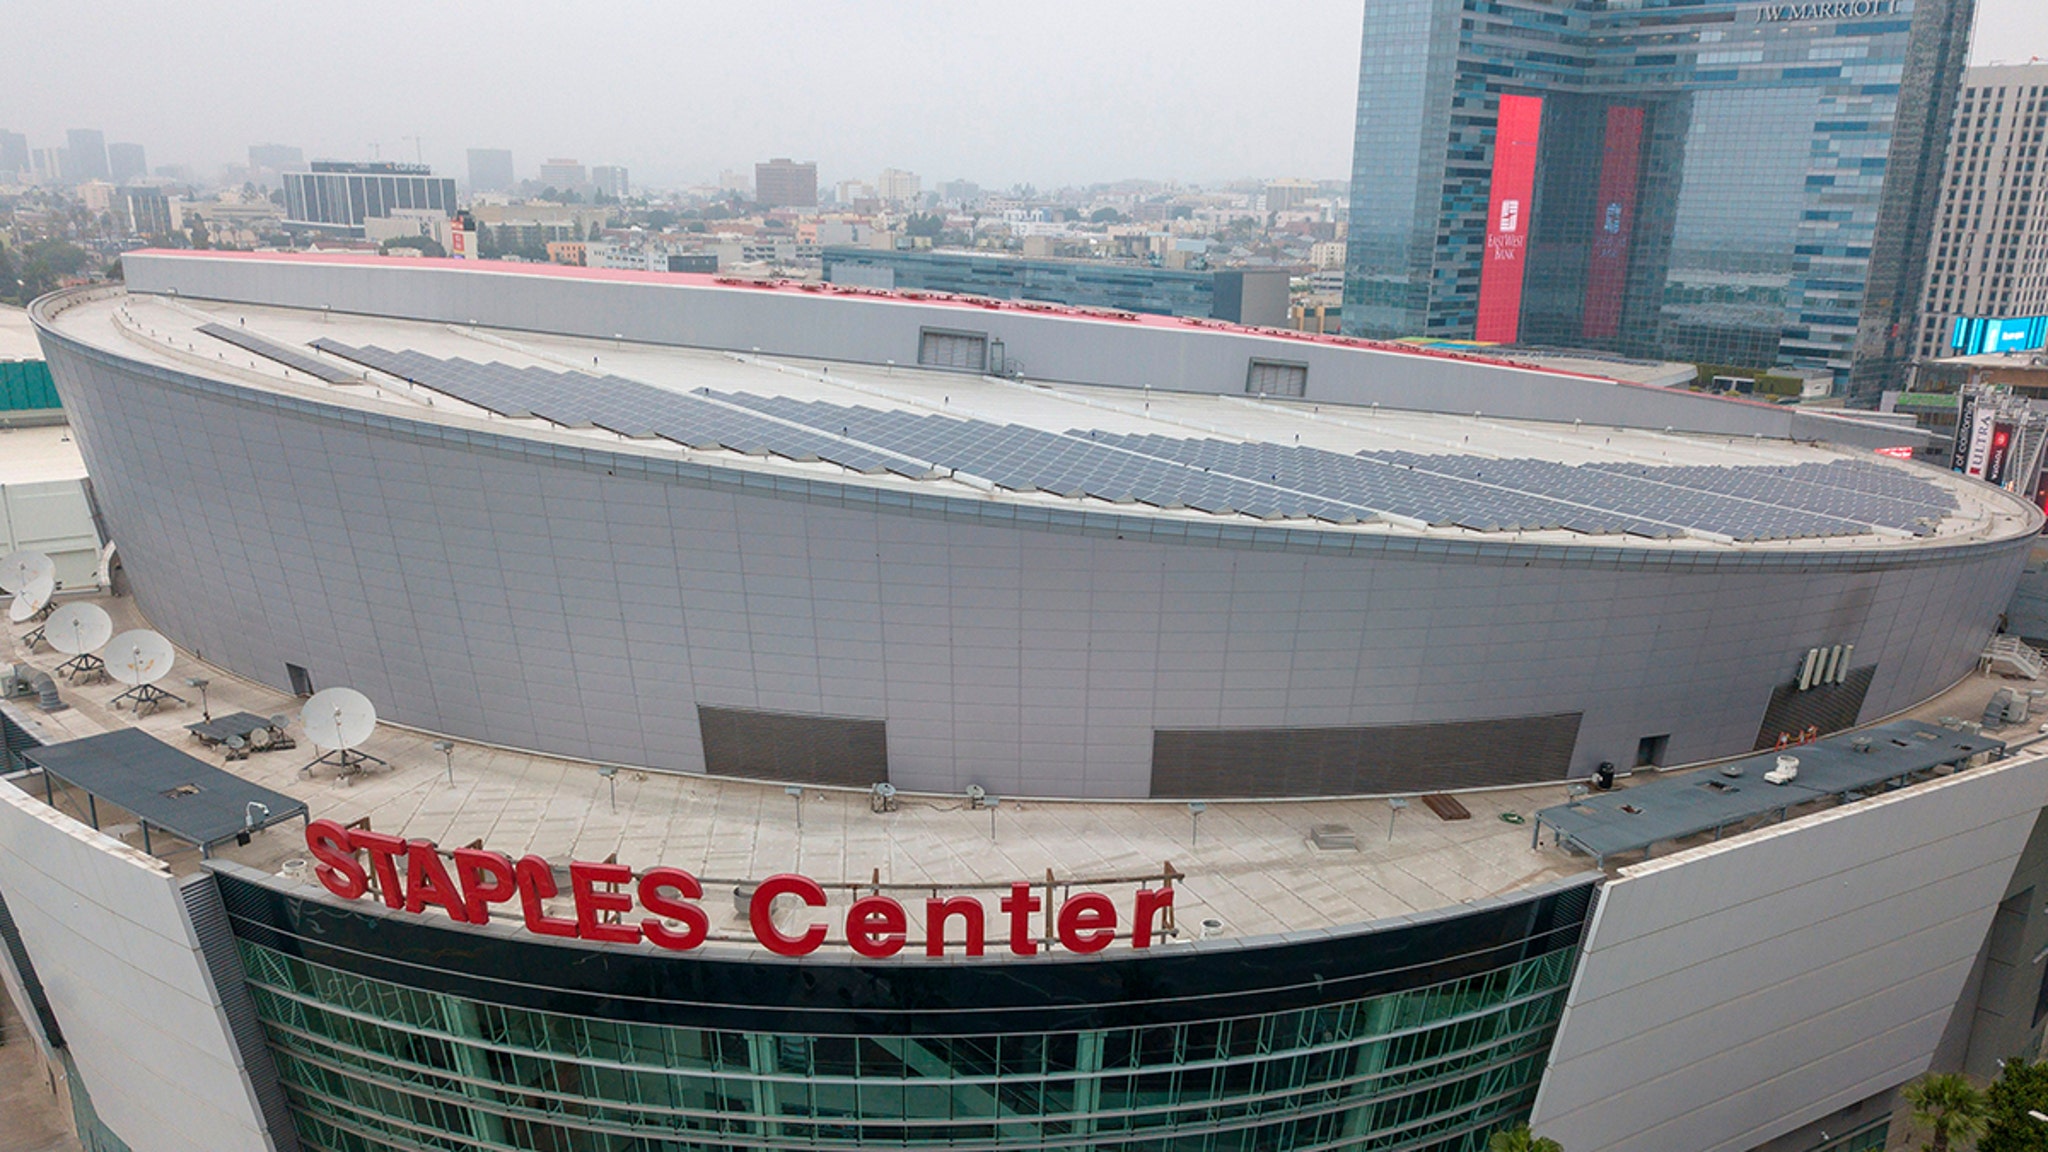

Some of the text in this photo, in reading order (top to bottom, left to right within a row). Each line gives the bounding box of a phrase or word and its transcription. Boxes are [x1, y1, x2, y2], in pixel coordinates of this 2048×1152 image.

[1755, 0, 1901, 23] JW MARRIOTT
[1972, 416, 1991, 466] ULTRA
[1991, 449, 2003, 480] TOYOTA
[306, 820, 1174, 959] STAPLES Center
